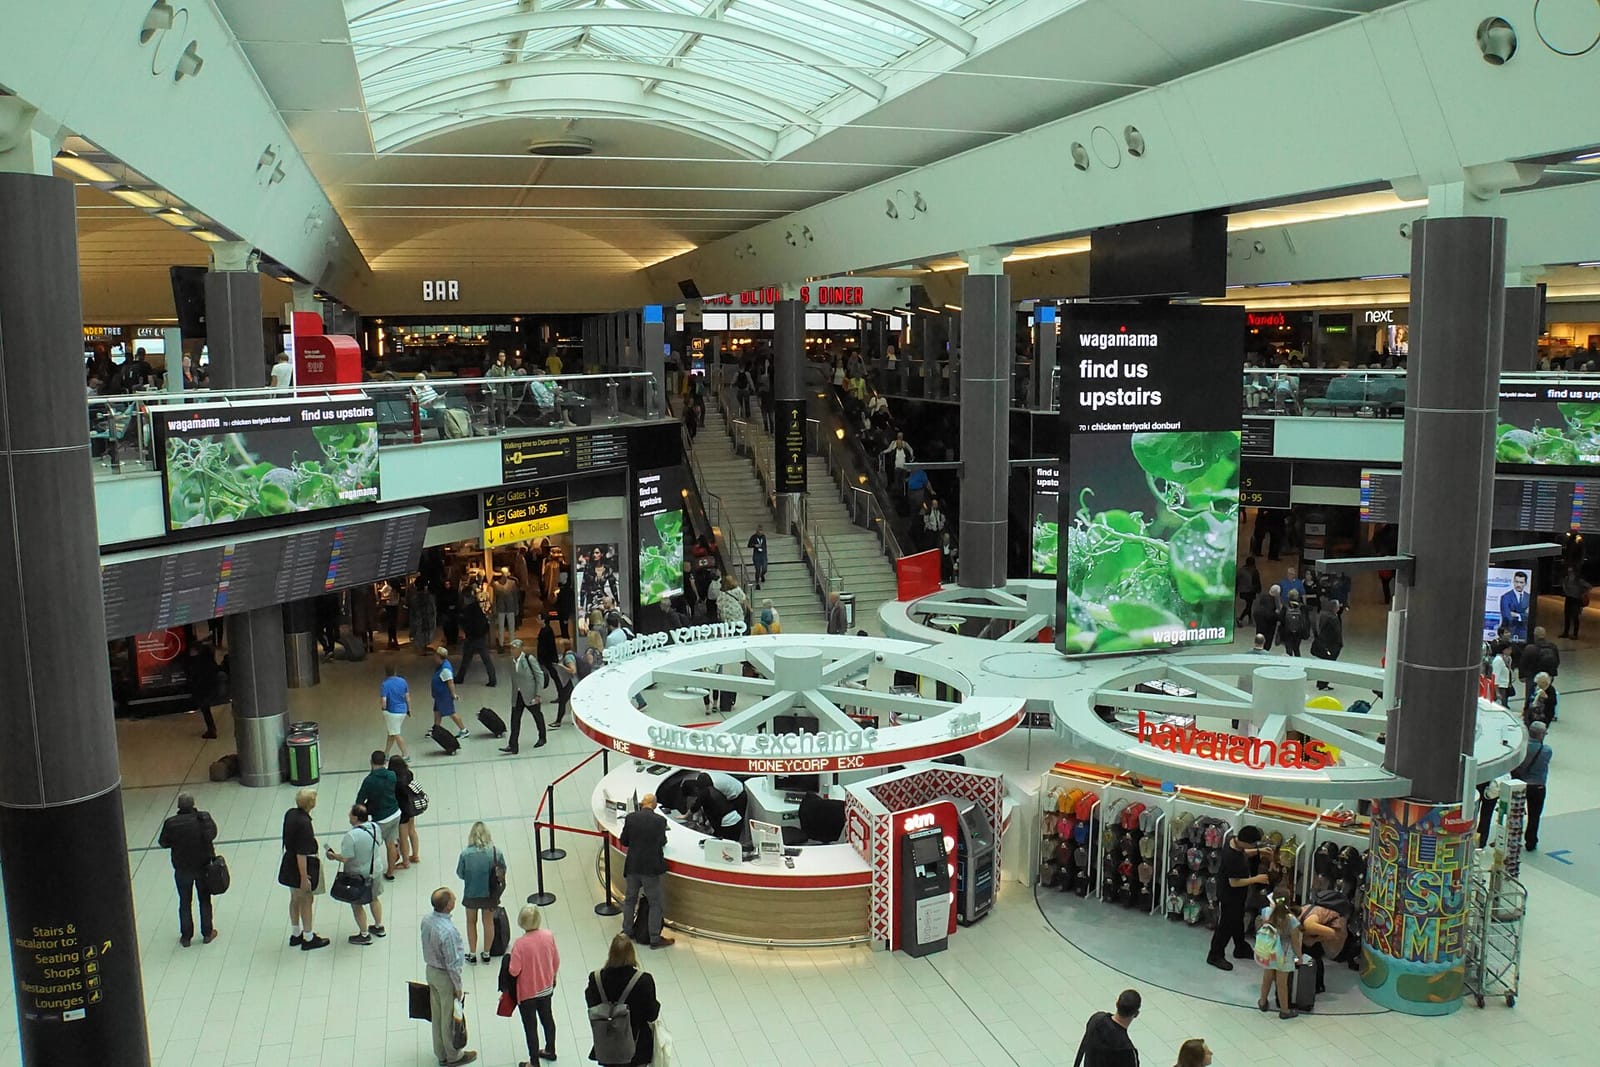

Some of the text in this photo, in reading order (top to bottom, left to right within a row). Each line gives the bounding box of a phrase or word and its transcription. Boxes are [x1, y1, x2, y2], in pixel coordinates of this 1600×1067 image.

[423, 280, 459, 301] BAR
[819, 286, 863, 304] DINER
[1247, 313, 1285, 325] Nando's
[1365, 310, 1394, 323] next
[83, 327, 121, 335] NDERTREE
[1080, 334, 1158, 350] wagamama
[1079, 360, 1148, 378] find us
[1079, 387, 1162, 411] upstairs
[1548, 389, 1568, 398] find
[168, 417, 220, 432] wagamama
[301, 409, 321, 421] find
[322, 410, 335, 420] us
[336, 407, 374, 422] upstairs
[1091, 423, 1121, 431] chicken
[1122, 422, 1151, 432] teriyaki
[1151, 421, 1181, 430] donburi
[1579, 454, 1600, 463] waga
[1037, 468, 1052, 476] find
[1037, 478, 1059, 488] upsta
[1242, 478, 1252, 487] -5
[339, 487, 378, 500] wagamama
[507, 488, 540, 501] Gates 1-5
[1240, 492, 1262, 502] 0-95
[507, 504, 548, 519] Gates 10-95
[528, 522, 550, 533] Toilets
[1152, 627, 1226, 645] wagamama
[647, 724, 878, 754] currency exchange
[1138, 710, 1328, 770] havaianas
[748, 759, 830, 773] MONEYCORP
[904, 813, 934, 832] atm
[32, 924, 76, 937] Stairs &
[61, 938, 78, 948] to:
[35, 952, 80, 964] Seating
[44, 966, 81, 979] Shops
[35, 996, 84, 1009] Lounges
